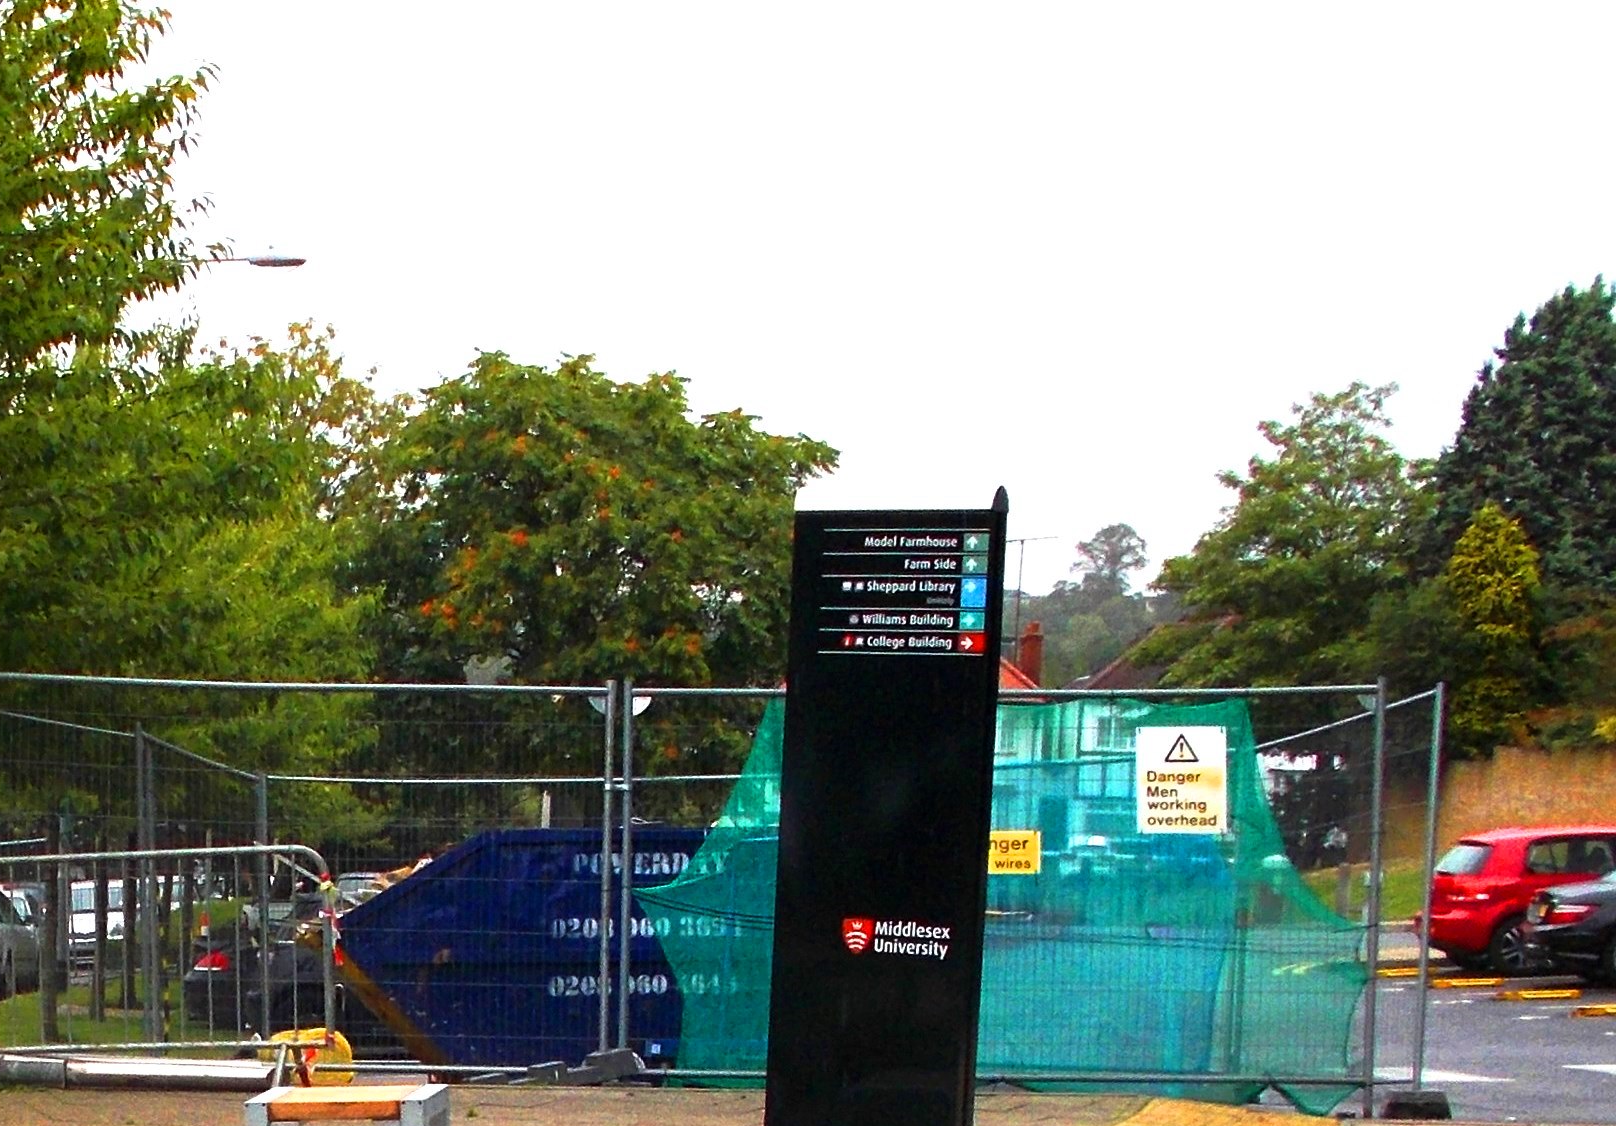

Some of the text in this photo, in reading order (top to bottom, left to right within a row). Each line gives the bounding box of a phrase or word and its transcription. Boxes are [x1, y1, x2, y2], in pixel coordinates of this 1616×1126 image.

[864, 535, 958, 548] Model Farmhouse
[904, 558, 957, 570] Farm Side
[867, 580, 956, 594] Sheppard Library
[862, 613, 954, 628] Williams Building
[867, 636, 953, 650] College Building
[1146, 770, 1201, 785] Danger
[1146, 786, 1178, 797] Men
[1147, 799, 1207, 813] working
[1147, 814, 1217, 826] overhead
[990, 839, 1029, 854] nger
[995, 858, 1031, 869] wires
[874, 921, 951, 940] Middlesex
[873, 938, 949, 960] University
